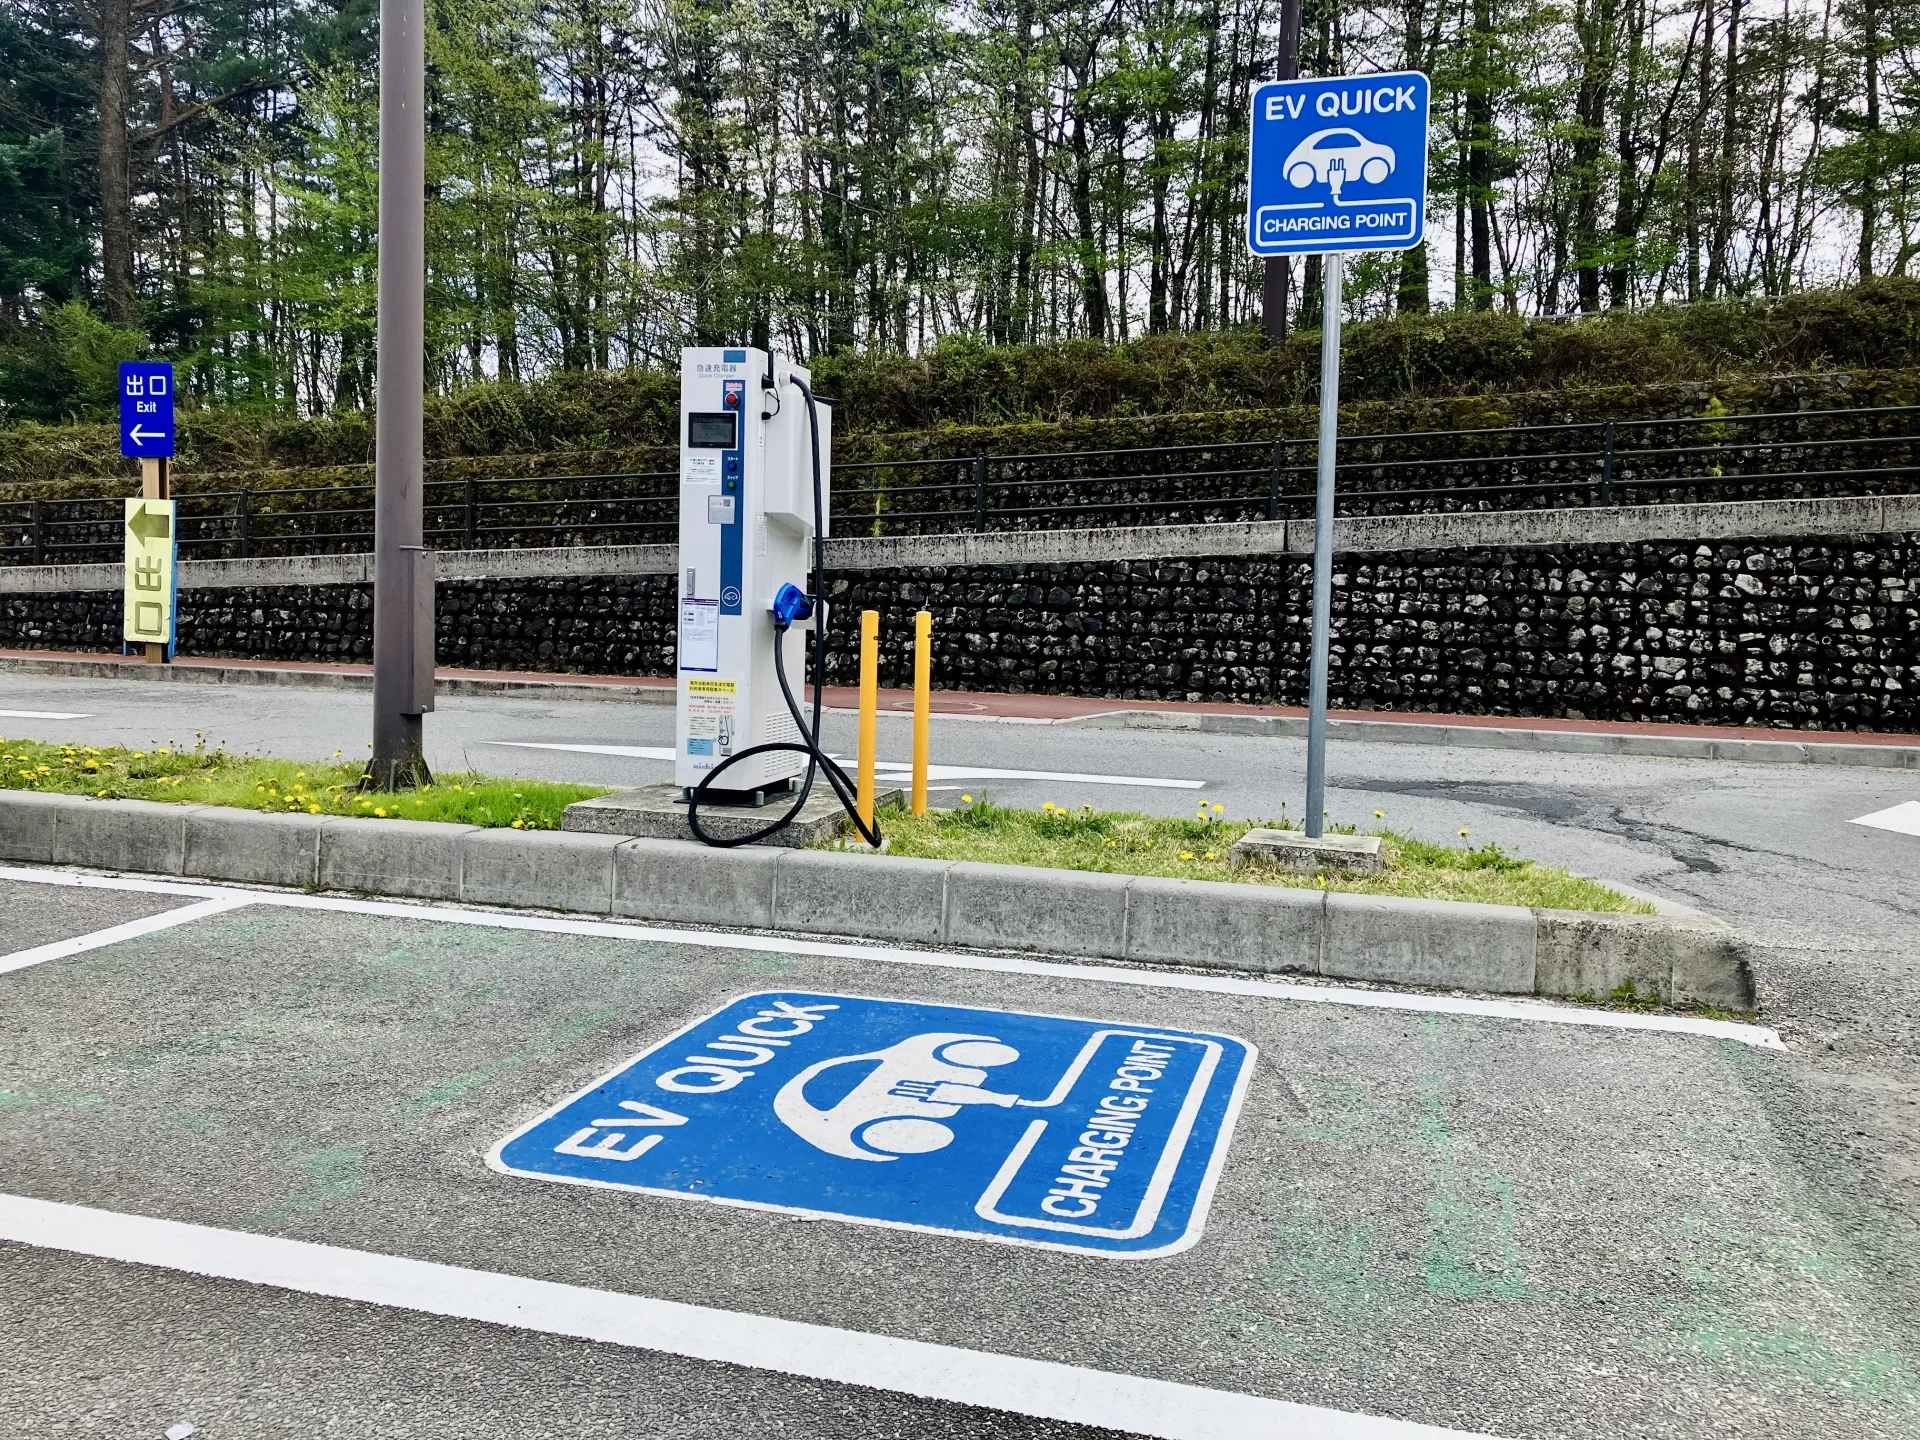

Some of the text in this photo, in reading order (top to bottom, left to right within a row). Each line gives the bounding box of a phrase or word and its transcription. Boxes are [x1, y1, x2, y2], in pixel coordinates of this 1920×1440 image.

[1265, 85, 1416, 121] EV QUICK
[1264, 212, 1408, 233] CHARGING POINT
[696, 363, 737, 373] 急速充電器
[126, 374, 167, 396] 出口
[136, 401, 157, 413] Exit
[134, 555, 162, 636] 出口
[553, 1001, 840, 1161] EV QUICK
[1041, 1039, 1176, 1218] CHARGING POINT
